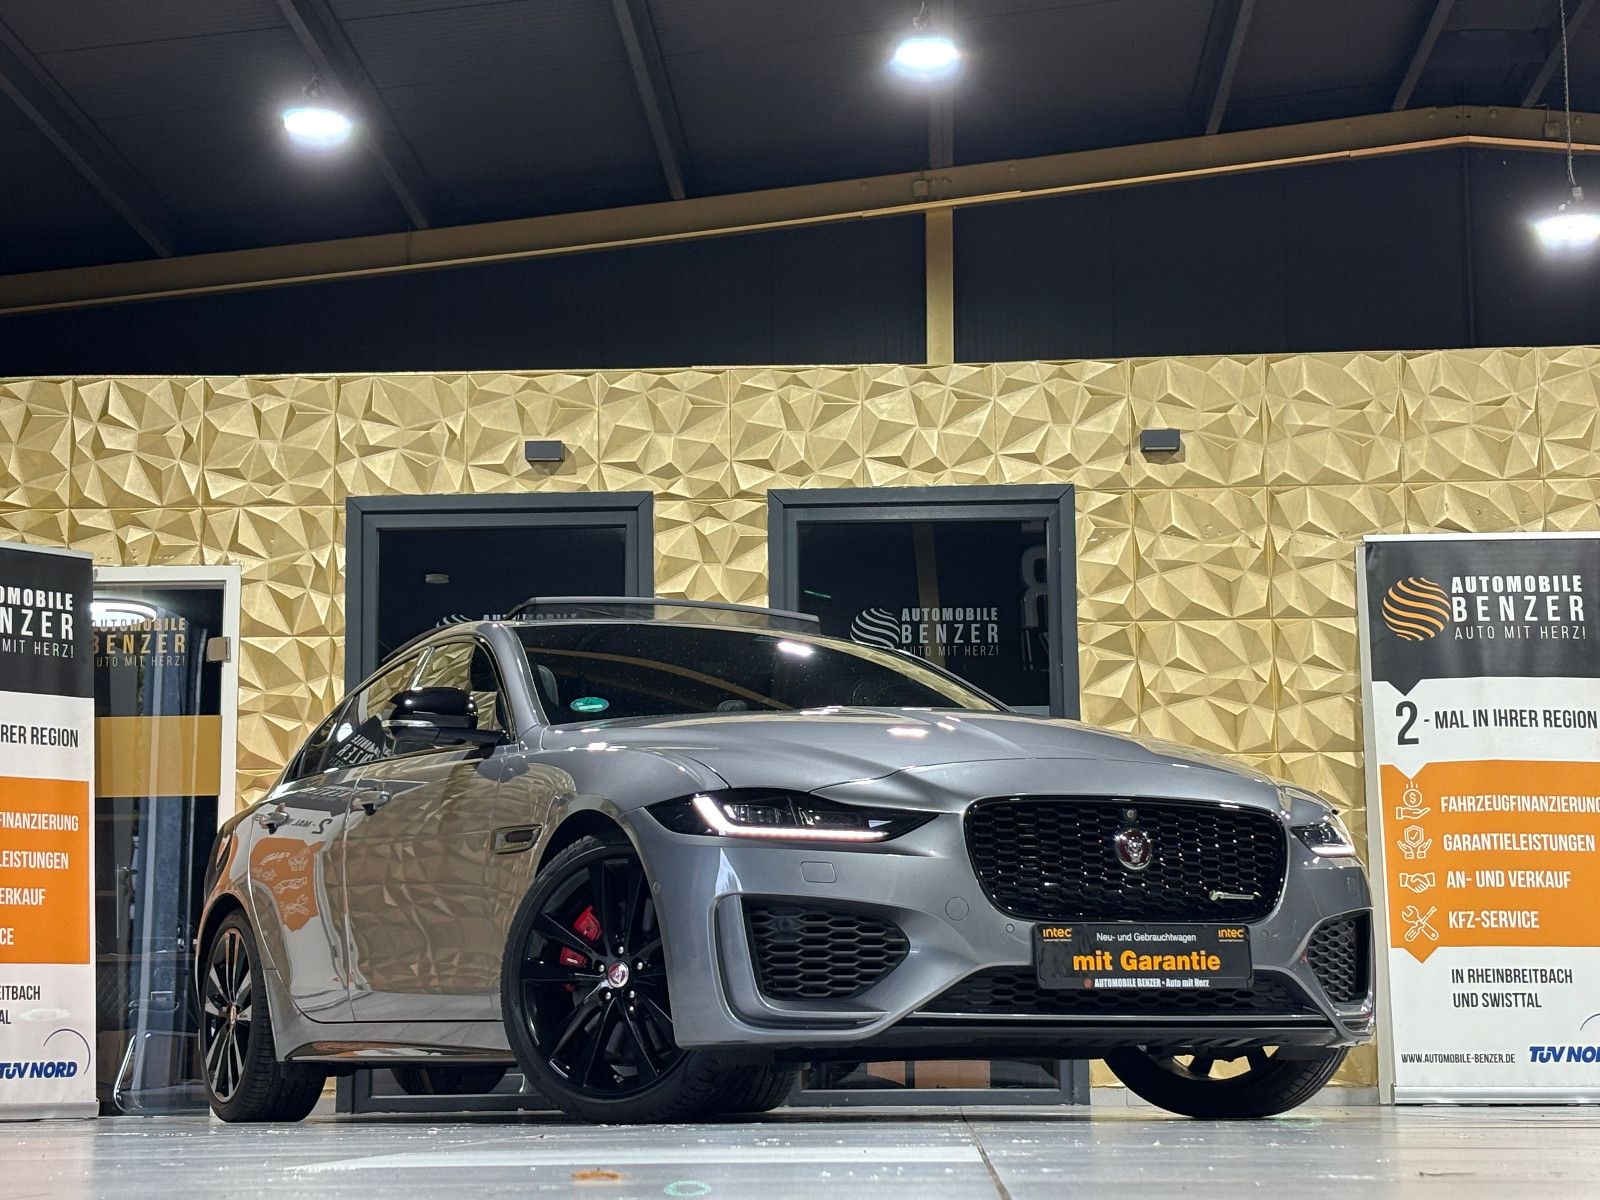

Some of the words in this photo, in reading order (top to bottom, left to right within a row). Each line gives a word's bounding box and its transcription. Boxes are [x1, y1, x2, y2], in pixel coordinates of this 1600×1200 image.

[1451, 575, 1583, 594] AUTOMOBILE
[901, 607, 998, 622] AUTOMOBILE
[1452, 595, 1585, 623] BENZER
[901, 623, 999, 644] BENZER
[1454, 625, 1496, 640] AUTO
[1504, 625, 1531, 640] MIT
[1540, 625, 1586, 640] HERZ!
[2, 637, 26, 654] MIT
[34, 641, 74, 659] HERZ!
[938, 645, 958, 657] MIT
[964, 645, 999, 656] HERZ!
[96, 656, 118, 668] UTO
[124, 655, 144, 668] MIT
[151, 655, 186, 667] HERZ!
[1395, 700, 1420, 746] 2
[1434, 710, 1470, 730] MAL
[1472, 709, 1489, 728] IN
[1493, 708, 1539, 728] IHRER
[1543, 709, 1598, 729] REGION
[30, 726, 79, 748] REGION
[1443, 832, 1596, 852] GARANTIELEISTUNGEN
[1446, 870, 1472, 889] AN-
[1475, 870, 1505, 889] UND
[1507, 870, 1572, 889] VERKAUF
[1448, 910, 1540, 929] KFZ-SERVICE
[1042, 928, 1072, 938] intec
[1096, 932, 1116, 942] Neu-
[1117, 932, 1132, 942] und
[1133, 933, 1197, 943] Gebrauchtwagen
[1218, 929, 1244, 938] intec
[1073, 950, 1113, 971] mit
[1120, 950, 1221, 971] Garantie
[1094, 978, 1137, 988] AUTOMOBILE
[1137, 978, 1161, 988] BENZER
[1165, 978, 1181, 988] Auto
[1182, 979, 1194, 988] mit
[1194, 978, 1210, 988] Herz
[1451, 968, 1464, 984] IN
[1467, 968, 1573, 984] RHEINBREITBACH
[1453, 992, 1479, 1008] UND
[1481, 992, 1542, 1008] SWISTTAL
[1401, 1053, 1516, 1064] WWW.AUTOMOBILE-BENZER.DE
[29, 1061, 77, 1079] NORD
